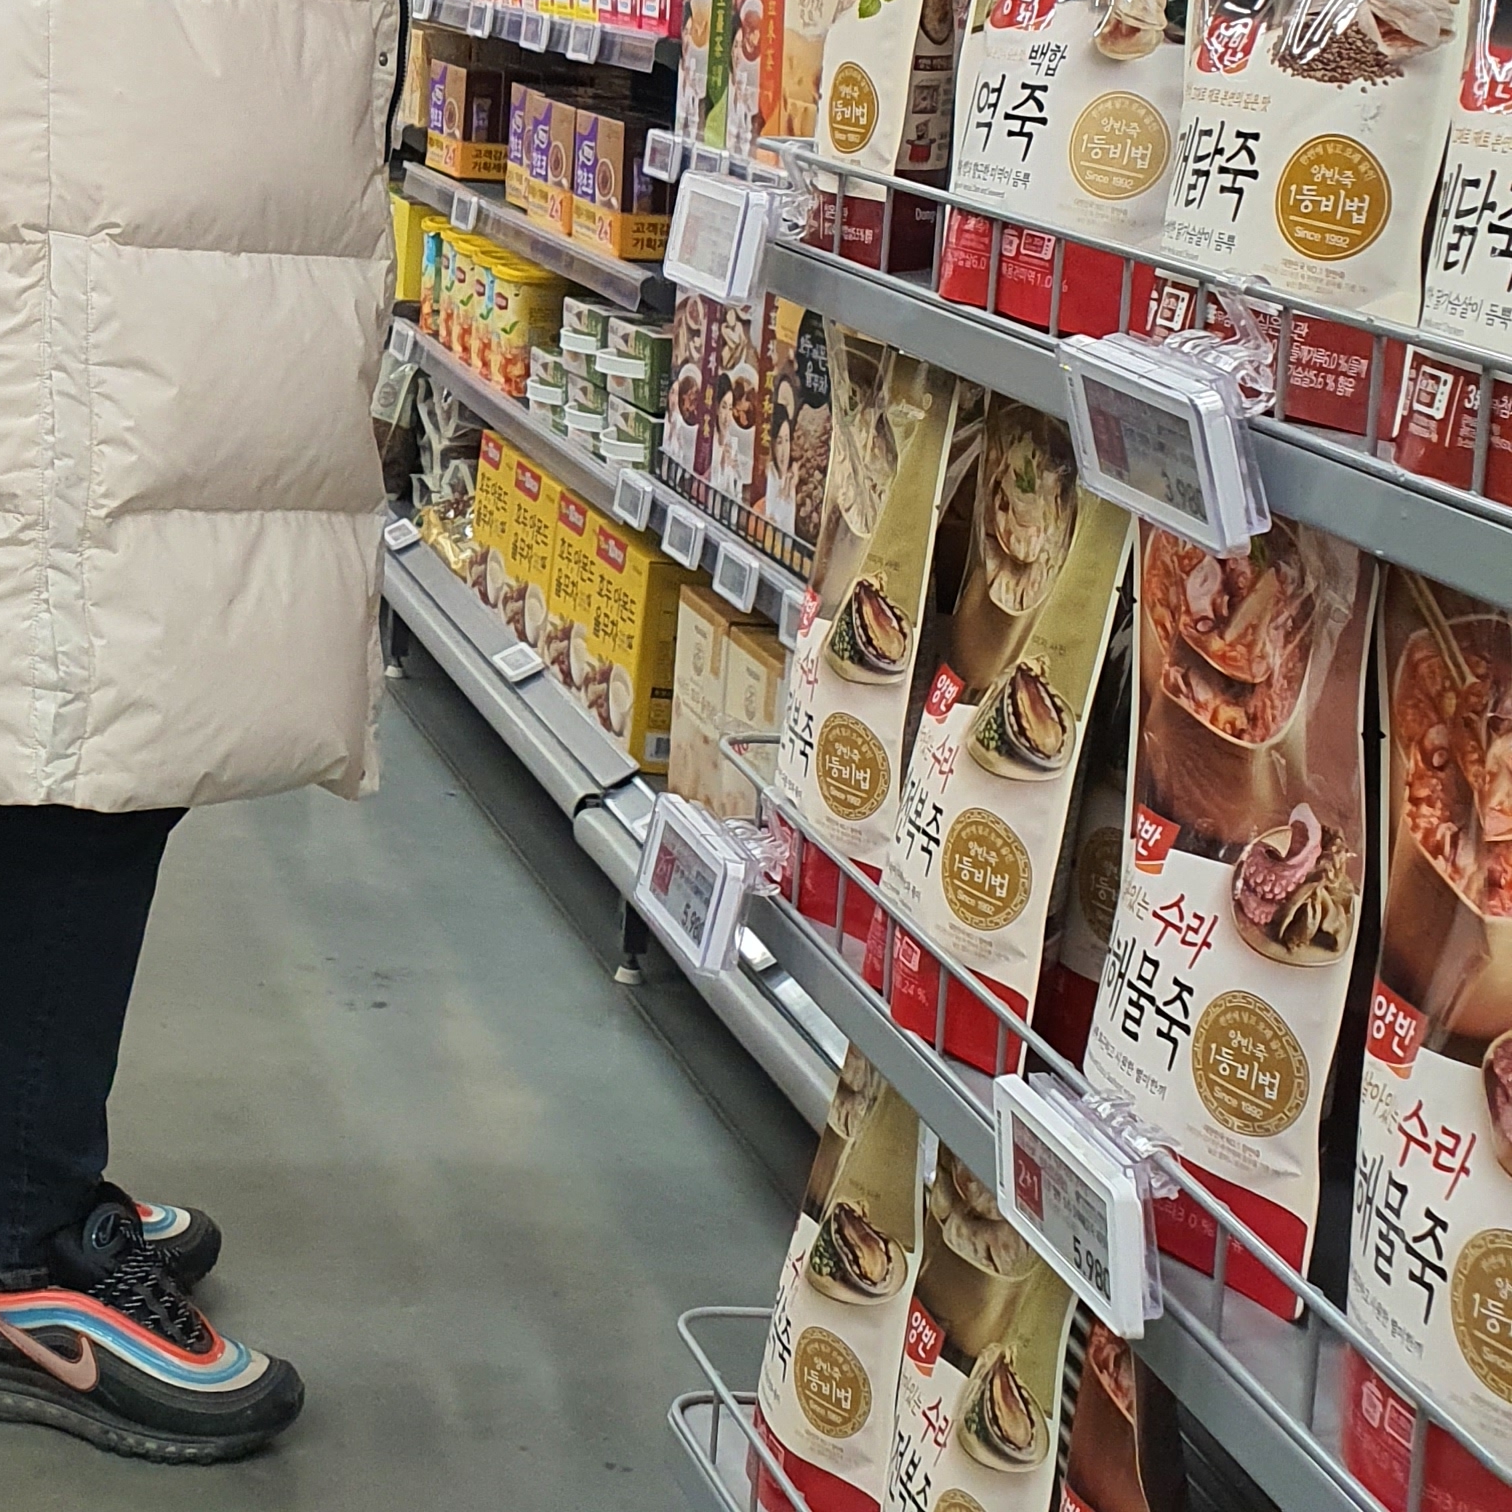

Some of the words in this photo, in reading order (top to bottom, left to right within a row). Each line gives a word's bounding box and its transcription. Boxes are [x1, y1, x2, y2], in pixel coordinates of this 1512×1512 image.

[1028, 40, 1068, 78] 백합
[1101, 117, 1142, 138] 양반죽
[1081, 132, 1154, 170] 1등비법
[1012, 170, 1031, 191] 듬뿍
[1310, 163, 1357, 189] 양반죽
[915, 207, 937, 224] Dong
[1289, 183, 1371, 225] 1등비법
[1214, 231, 1236, 255] 듬뿍
[1294, 225, 1321, 243] Since
[1324, 230, 1351, 249] 1992
[930, 672, 958, 711] 양반
[825, 754, 872, 791] 1등비법
[1137, 816, 1163, 858] 반
[953, 854, 1010, 897] 1등비법
[1151, 892, 1220, 970] 수라
[1100, 920, 1196, 1072] 해물죽
[1372, 994, 1416, 1058] 양반
[1228, 1030, 1269, 1066] 양반죽
[1209, 1042, 1281, 1101] 1등비법
[1396, 1098, 1477, 1202] 수라
[1355, 1152, 1449, 1326] 해물죽
[908, 1310, 938, 1359] 양반
[1473, 1293, 1512, 1335] 1등
[921, 1396, 954, 1467] 수라
